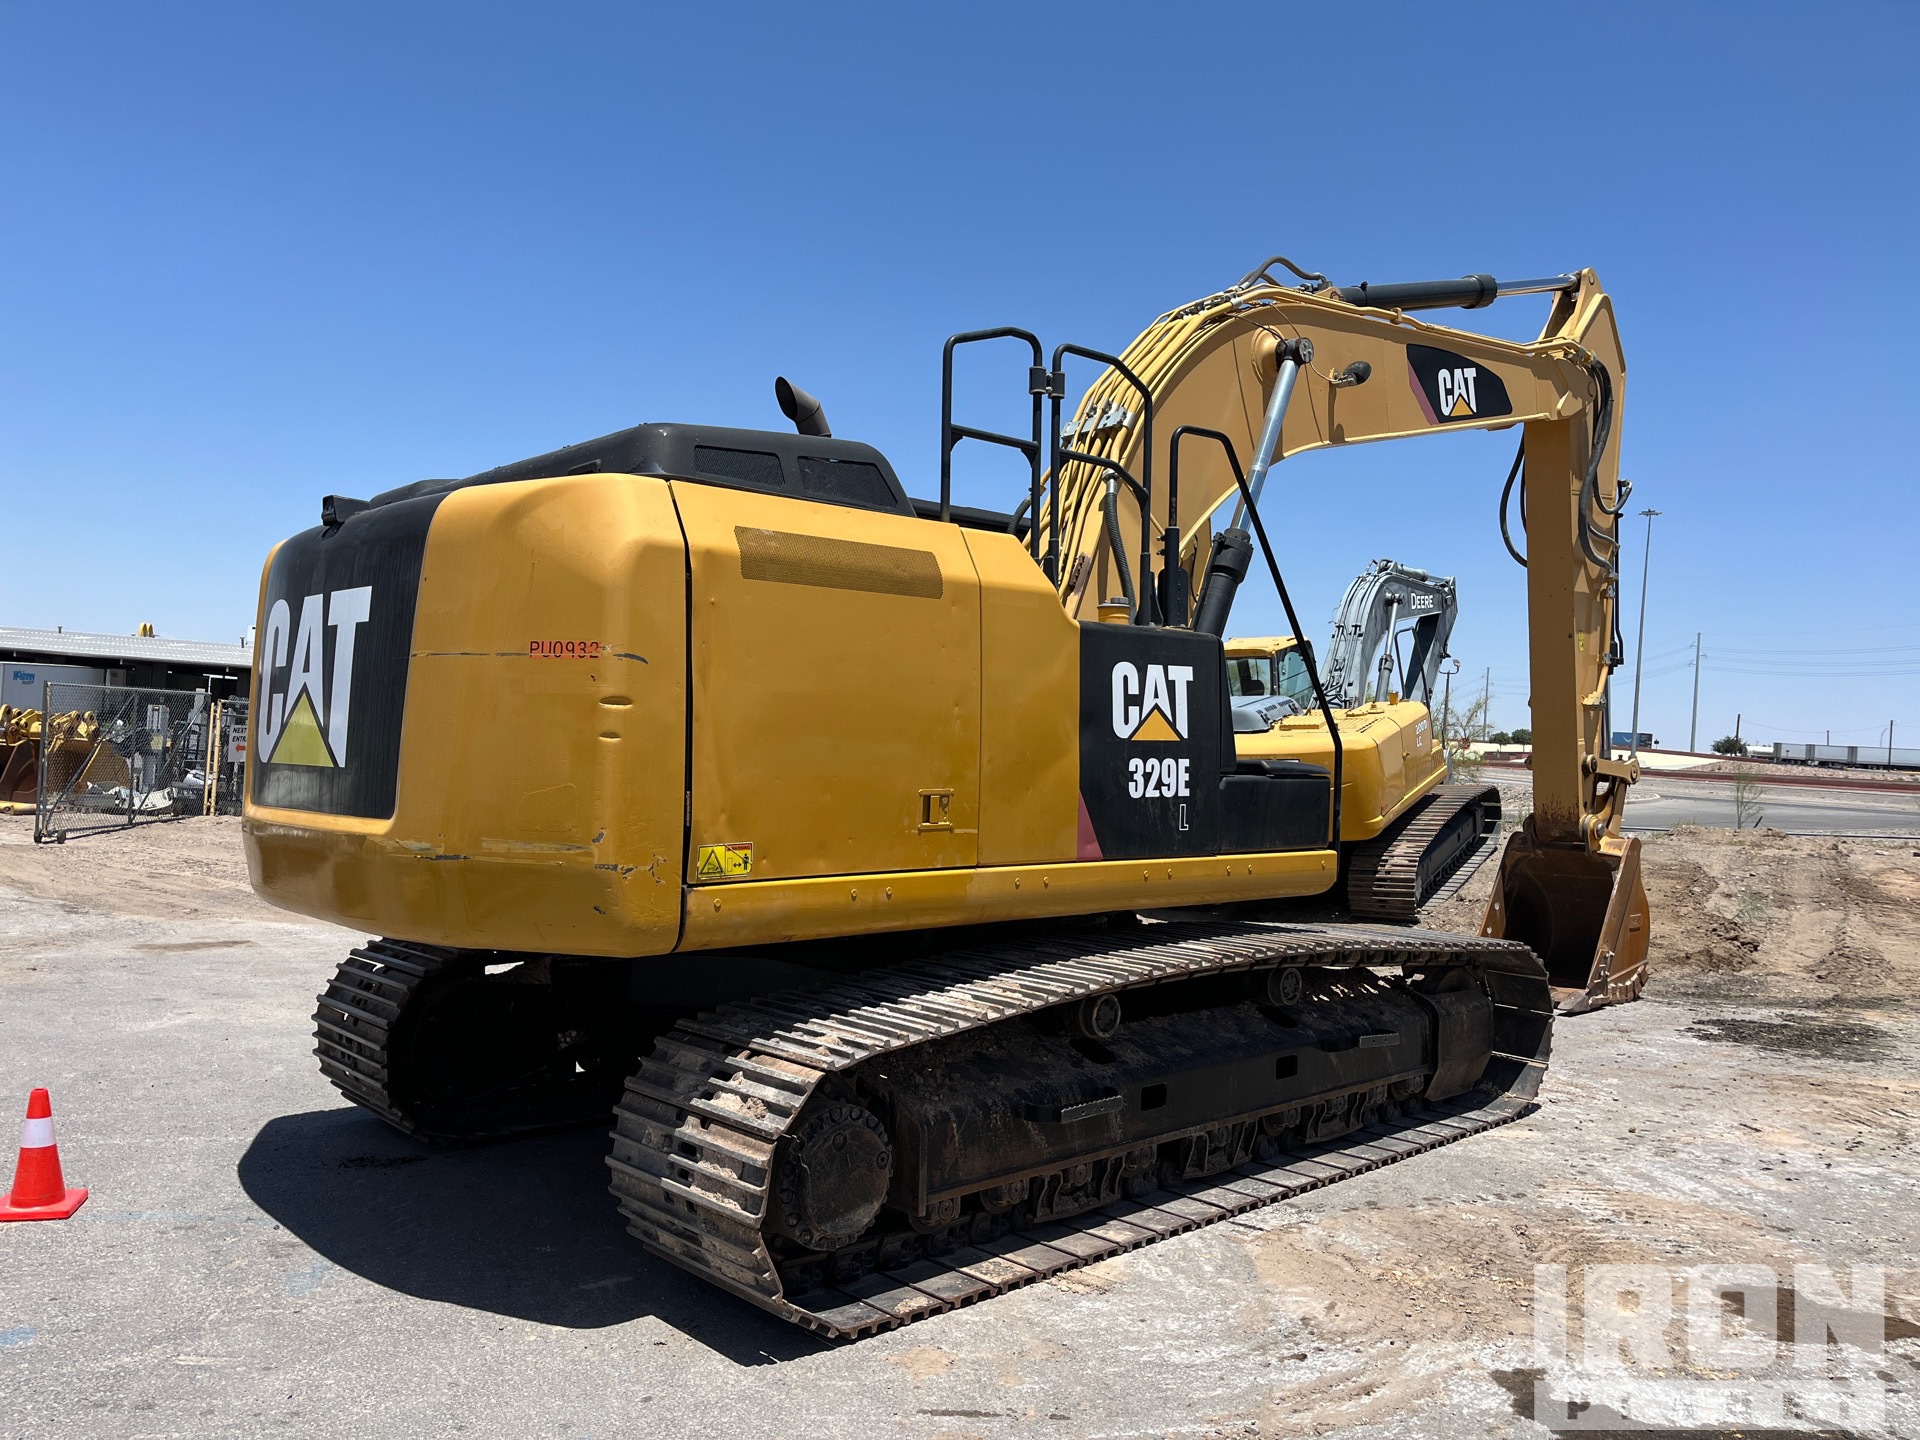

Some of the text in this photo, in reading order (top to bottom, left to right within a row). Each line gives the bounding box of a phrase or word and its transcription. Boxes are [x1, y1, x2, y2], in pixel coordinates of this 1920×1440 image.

[1437, 367, 1477, 417] CAT
[1410, 592, 1434, 610] DEERE
[529, 640, 599, 658] PU0932
[258, 585, 372, 768] CAT
[1111, 661, 1194, 740] CAT
[1128, 757, 1190, 798] 329E
[1178, 803, 1189, 830] L
